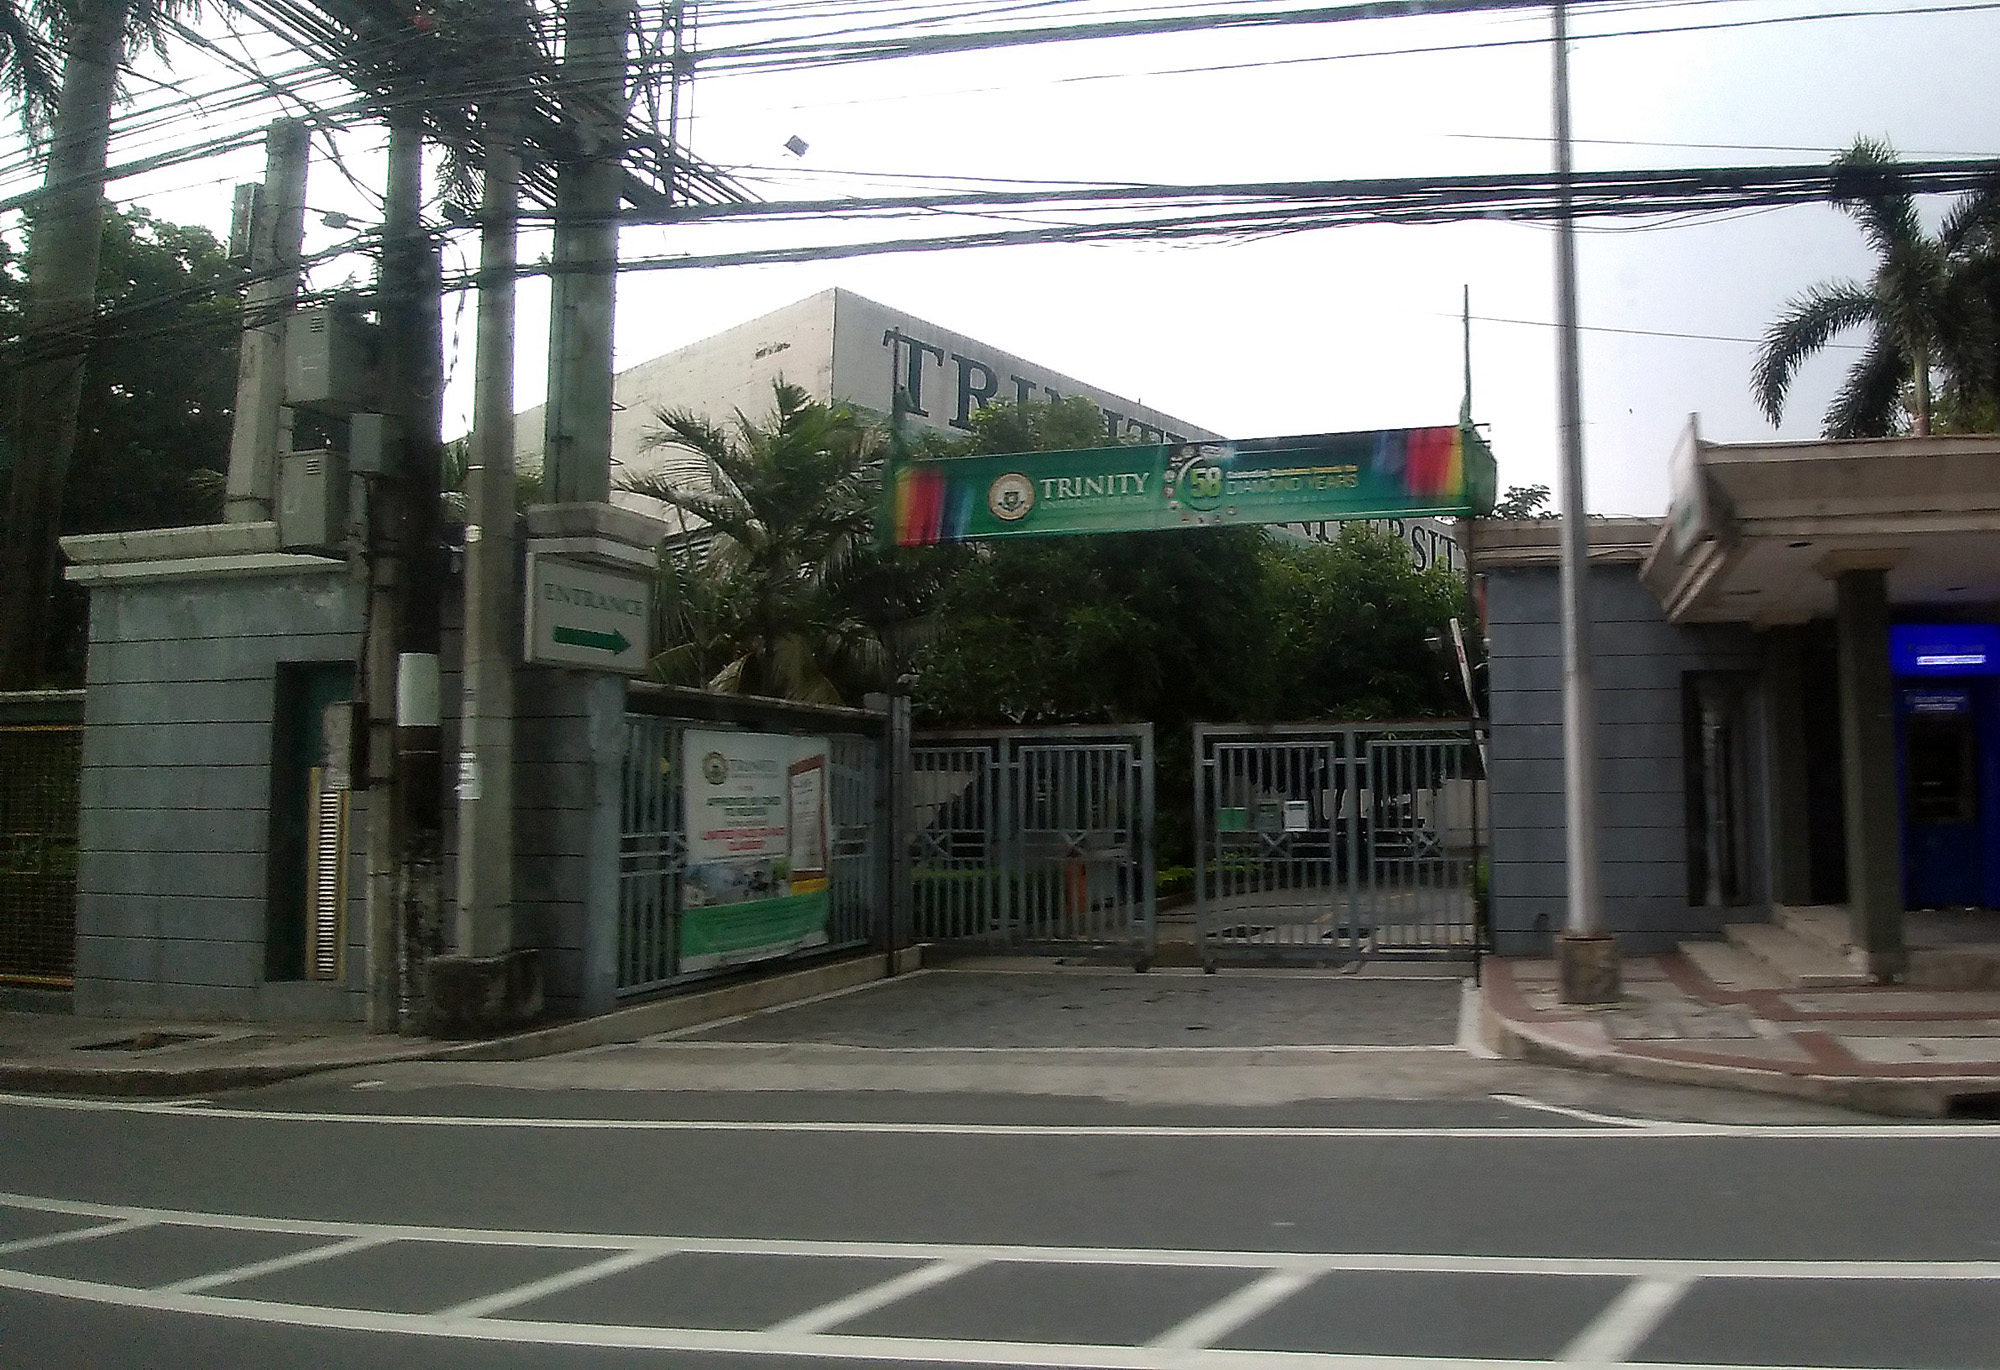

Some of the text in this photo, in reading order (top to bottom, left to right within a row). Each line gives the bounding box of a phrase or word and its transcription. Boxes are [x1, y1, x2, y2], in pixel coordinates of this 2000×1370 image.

[1039, 472, 1150, 499] TRINITY
[1190, 467, 1222, 498] 58
[544, 583, 643, 617] ENTRANCE
